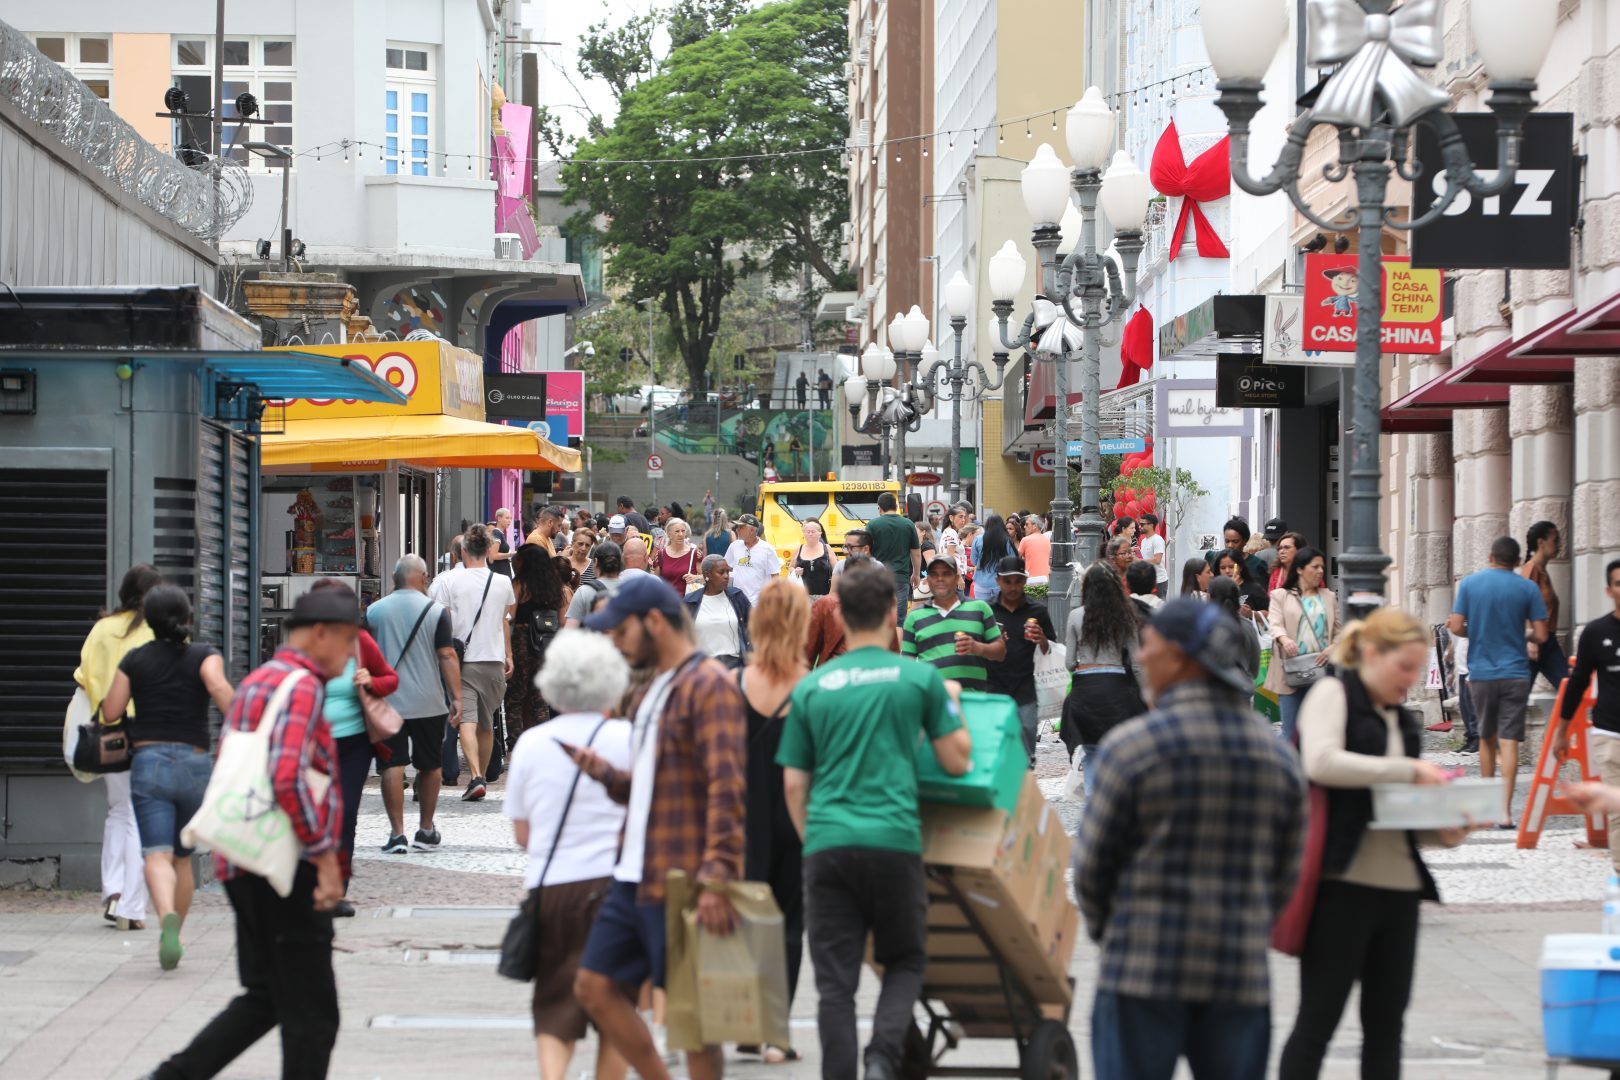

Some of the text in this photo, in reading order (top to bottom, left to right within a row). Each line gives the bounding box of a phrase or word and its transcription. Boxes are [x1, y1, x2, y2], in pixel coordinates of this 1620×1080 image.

[1431, 169, 1555, 216] STZ
[1392, 271, 1412, 280] NA
[1392, 282, 1429, 292] CASA
[1391, 293, 1434, 303] CHINA
[1391, 304, 1424, 313] TEM!
[1168, 398, 1195, 416] mil
